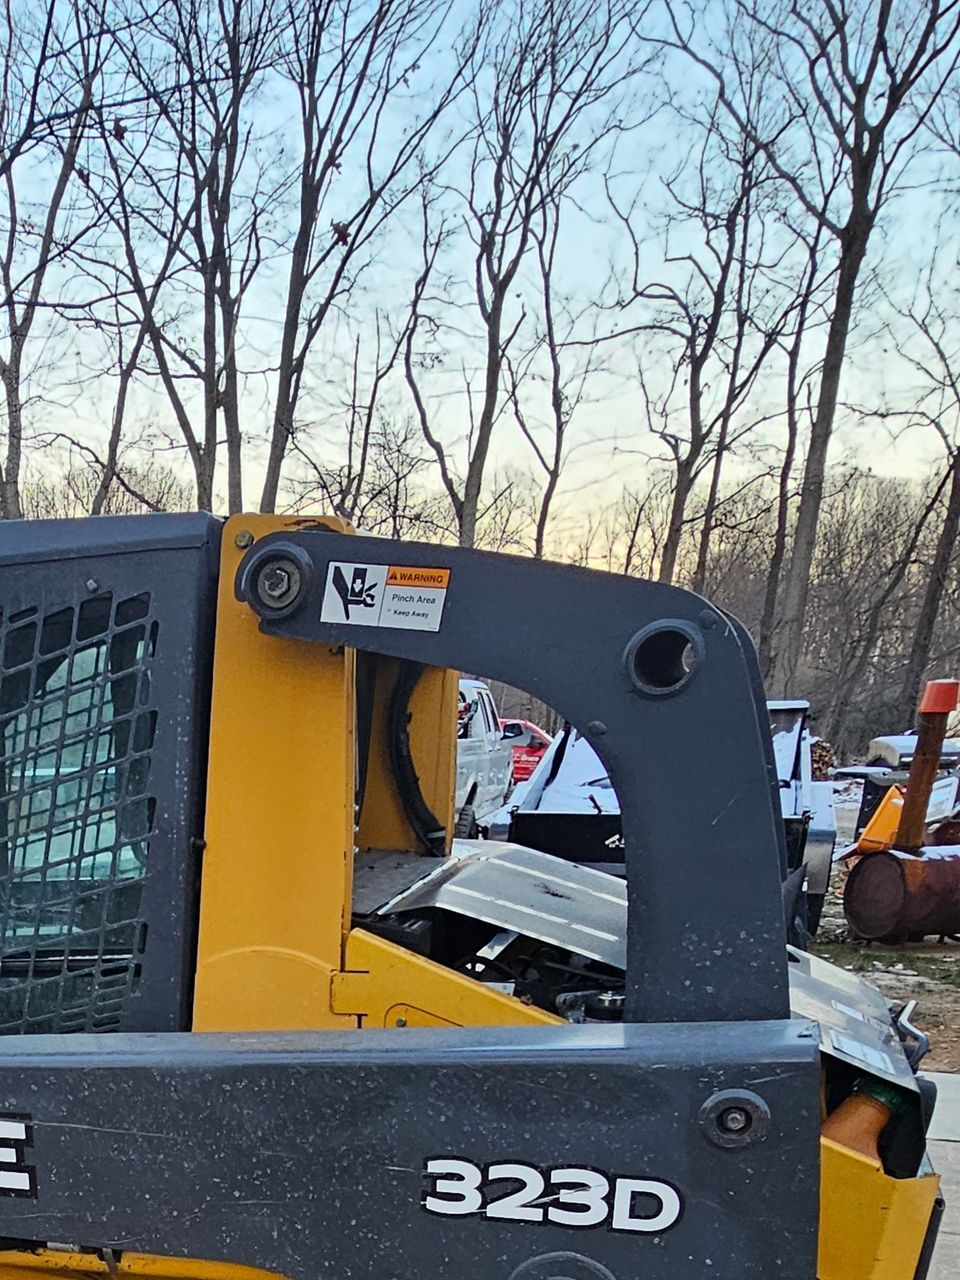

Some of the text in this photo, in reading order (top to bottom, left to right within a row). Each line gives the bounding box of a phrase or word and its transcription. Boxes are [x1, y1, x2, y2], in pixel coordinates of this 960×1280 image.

[400, 572, 443, 583] WARNING
[392, 593, 436, 604] Pinch Area
[393, 609, 429, 619] Keep Away
[426, 1159, 680, 1232] 323D
